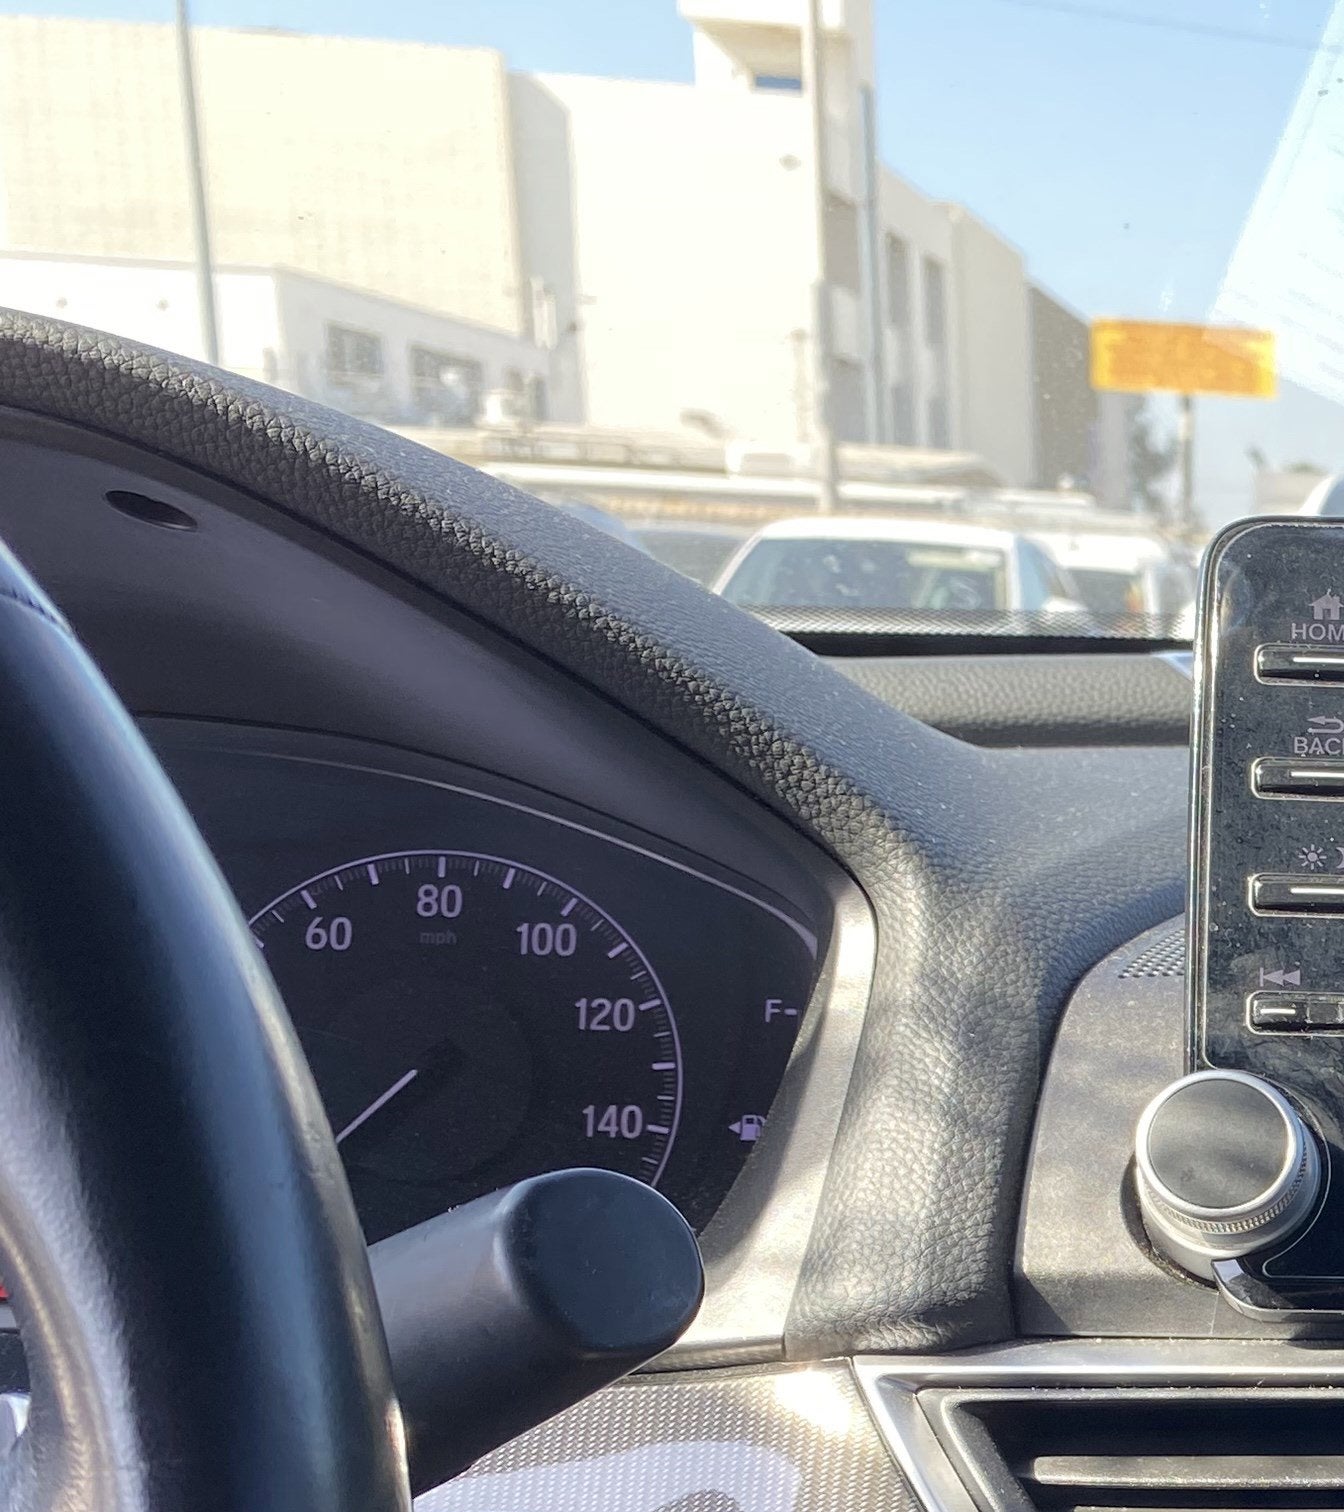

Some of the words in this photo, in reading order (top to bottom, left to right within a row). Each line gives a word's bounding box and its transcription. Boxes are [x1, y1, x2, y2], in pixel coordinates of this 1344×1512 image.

[415, 885, 464, 919] 80
[304, 917, 354, 952] 60
[419, 929, 458, 946] mph
[516, 923, 578, 957] 100
[575, 998, 636, 1032] 120
[583, 1105, 644, 1139] 140
